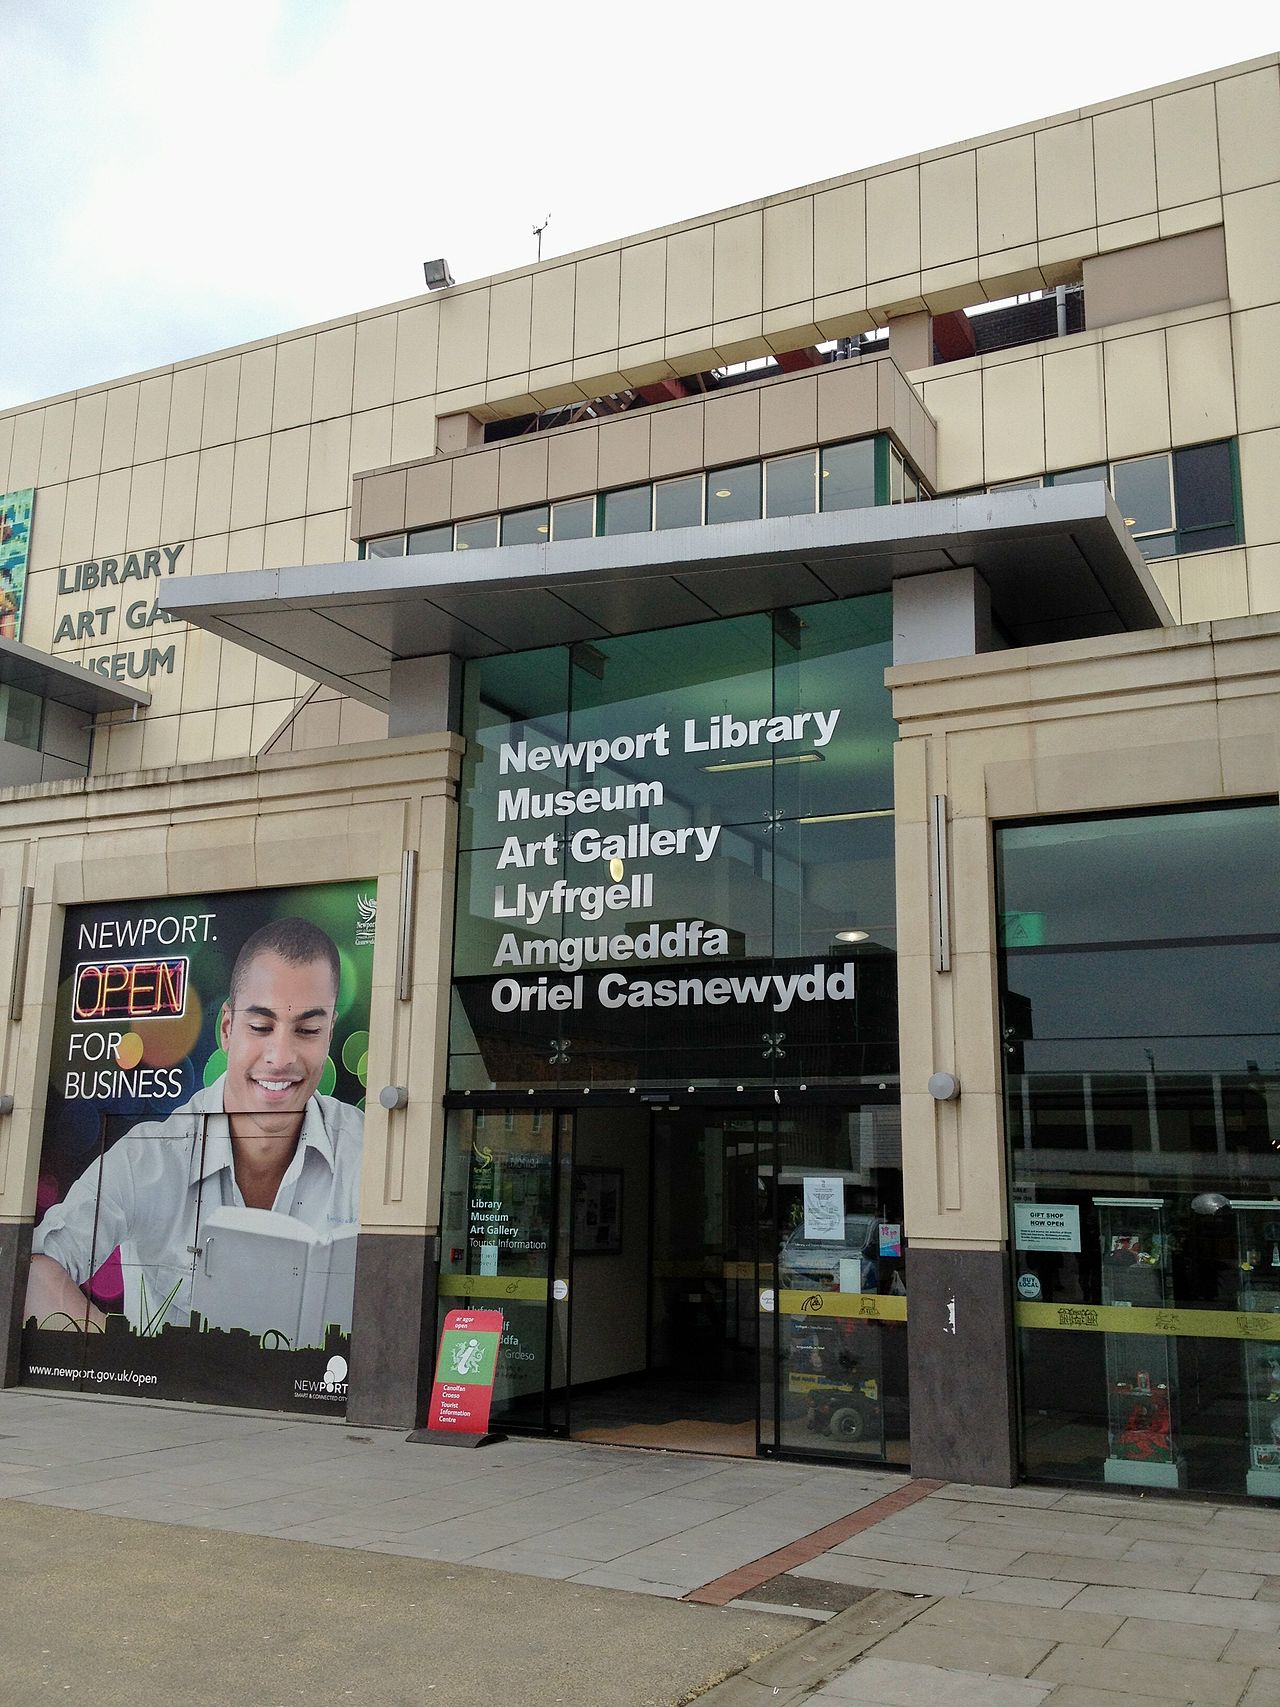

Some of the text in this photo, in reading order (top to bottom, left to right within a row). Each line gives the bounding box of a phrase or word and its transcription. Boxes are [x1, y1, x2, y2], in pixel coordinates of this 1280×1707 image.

[58, 544, 185, 595] LIBRARY
[54, 606, 115, 643] ART
[499, 709, 841, 775] Newport Library
[497, 779, 664, 822] Museum
[496, 824, 721, 870] Art Gallery
[494, 873, 653, 924] Llyfrgell
[78, 913, 218, 951] NEWPORT.
[492, 920, 729, 973] Amgueddfa
[75, 960, 185, 1018] OPEN
[491, 962, 855, 1013] Oriel Casnewydd
[67, 1032, 122, 1062] FOR
[64, 1068, 183, 1101] BUSINESS
[470, 1212, 509, 1222] Museum
[471, 1199, 502, 1210] Library
[469, 1225, 519, 1238] Art Gallery
[469, 1237, 547, 1250] Tourist Information
[29, 1365, 158, 1387] www.newport.gov.uk/open
[294, 1379, 349, 1394] NEWPORT
[443, 1384, 466, 1392] Canolfan
[442, 1391, 460, 1399] Croeso
[440, 1408, 471, 1417] Information
